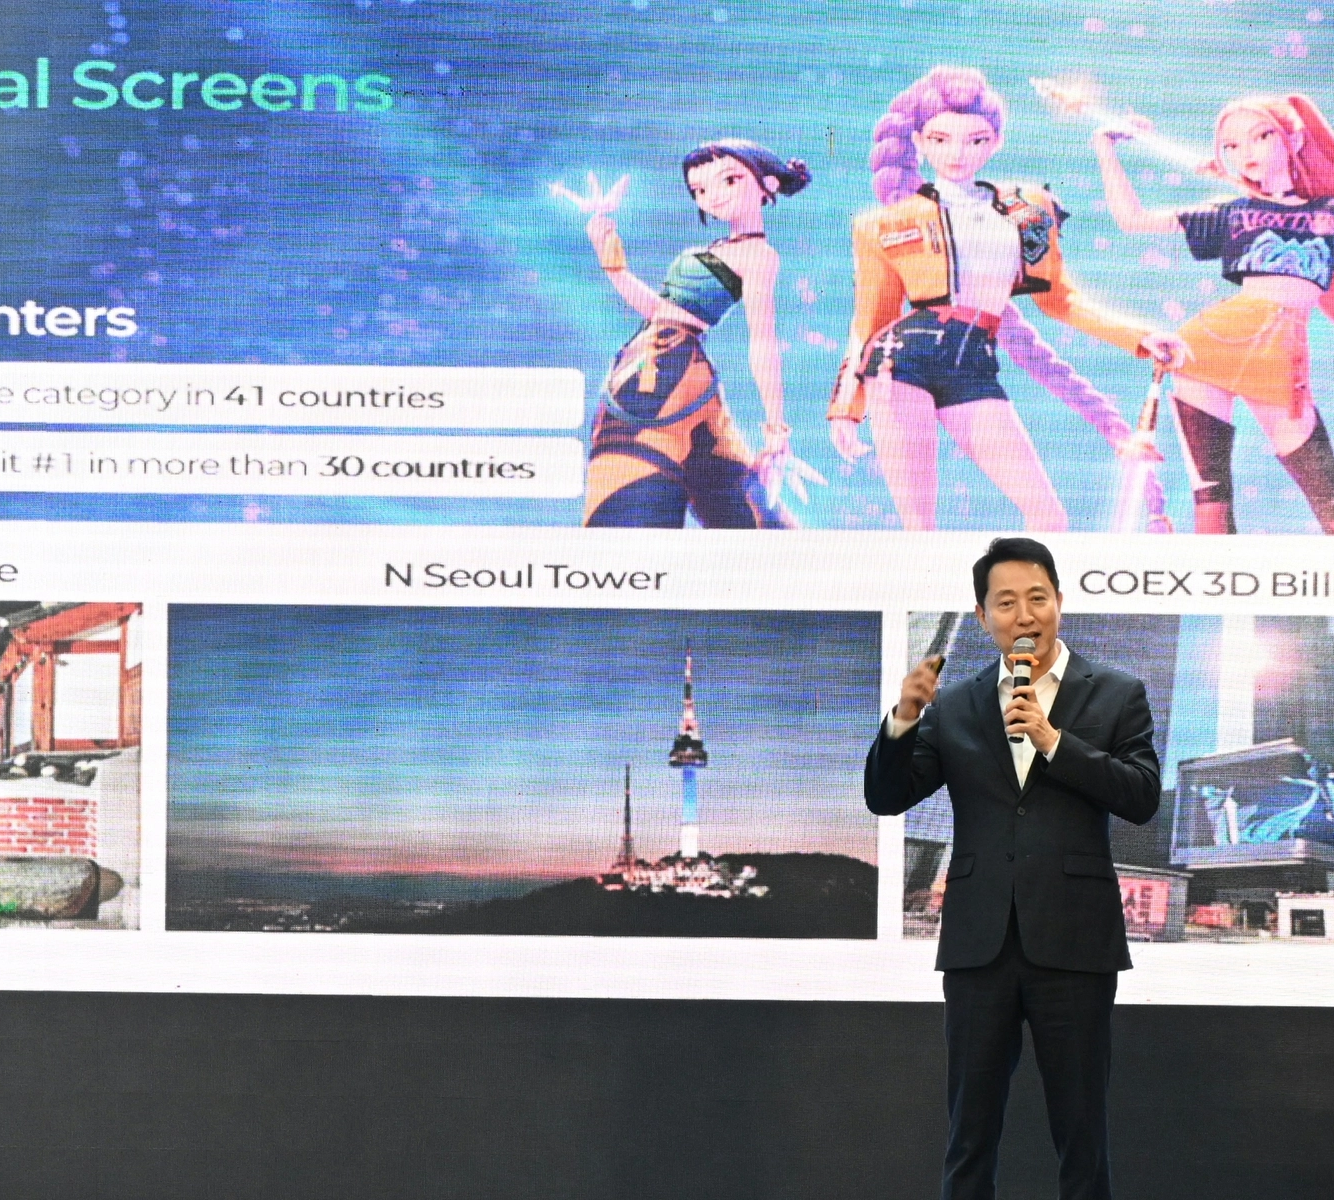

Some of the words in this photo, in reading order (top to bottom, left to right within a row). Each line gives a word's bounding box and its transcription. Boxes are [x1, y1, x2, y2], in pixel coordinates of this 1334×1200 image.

[72, 61, 394, 112] Screens
[23, 385, 174, 411] category
[184, 383, 215, 406] in
[224, 385, 265, 407] 41
[278, 386, 446, 409] countries
[31, 451, 75, 475] #1
[88, 451, 119, 475] in
[127, 457, 221, 476] more
[229, 452, 309, 477] than
[318, 454, 366, 478] 30
[370, 456, 537, 480] countries
[384, 563, 412, 587] N
[424, 563, 533, 589] Seoul
[544, 564, 667, 590] Tower
[1079, 569, 1192, 596] COEX
[1205, 571, 1260, 596] 3D
